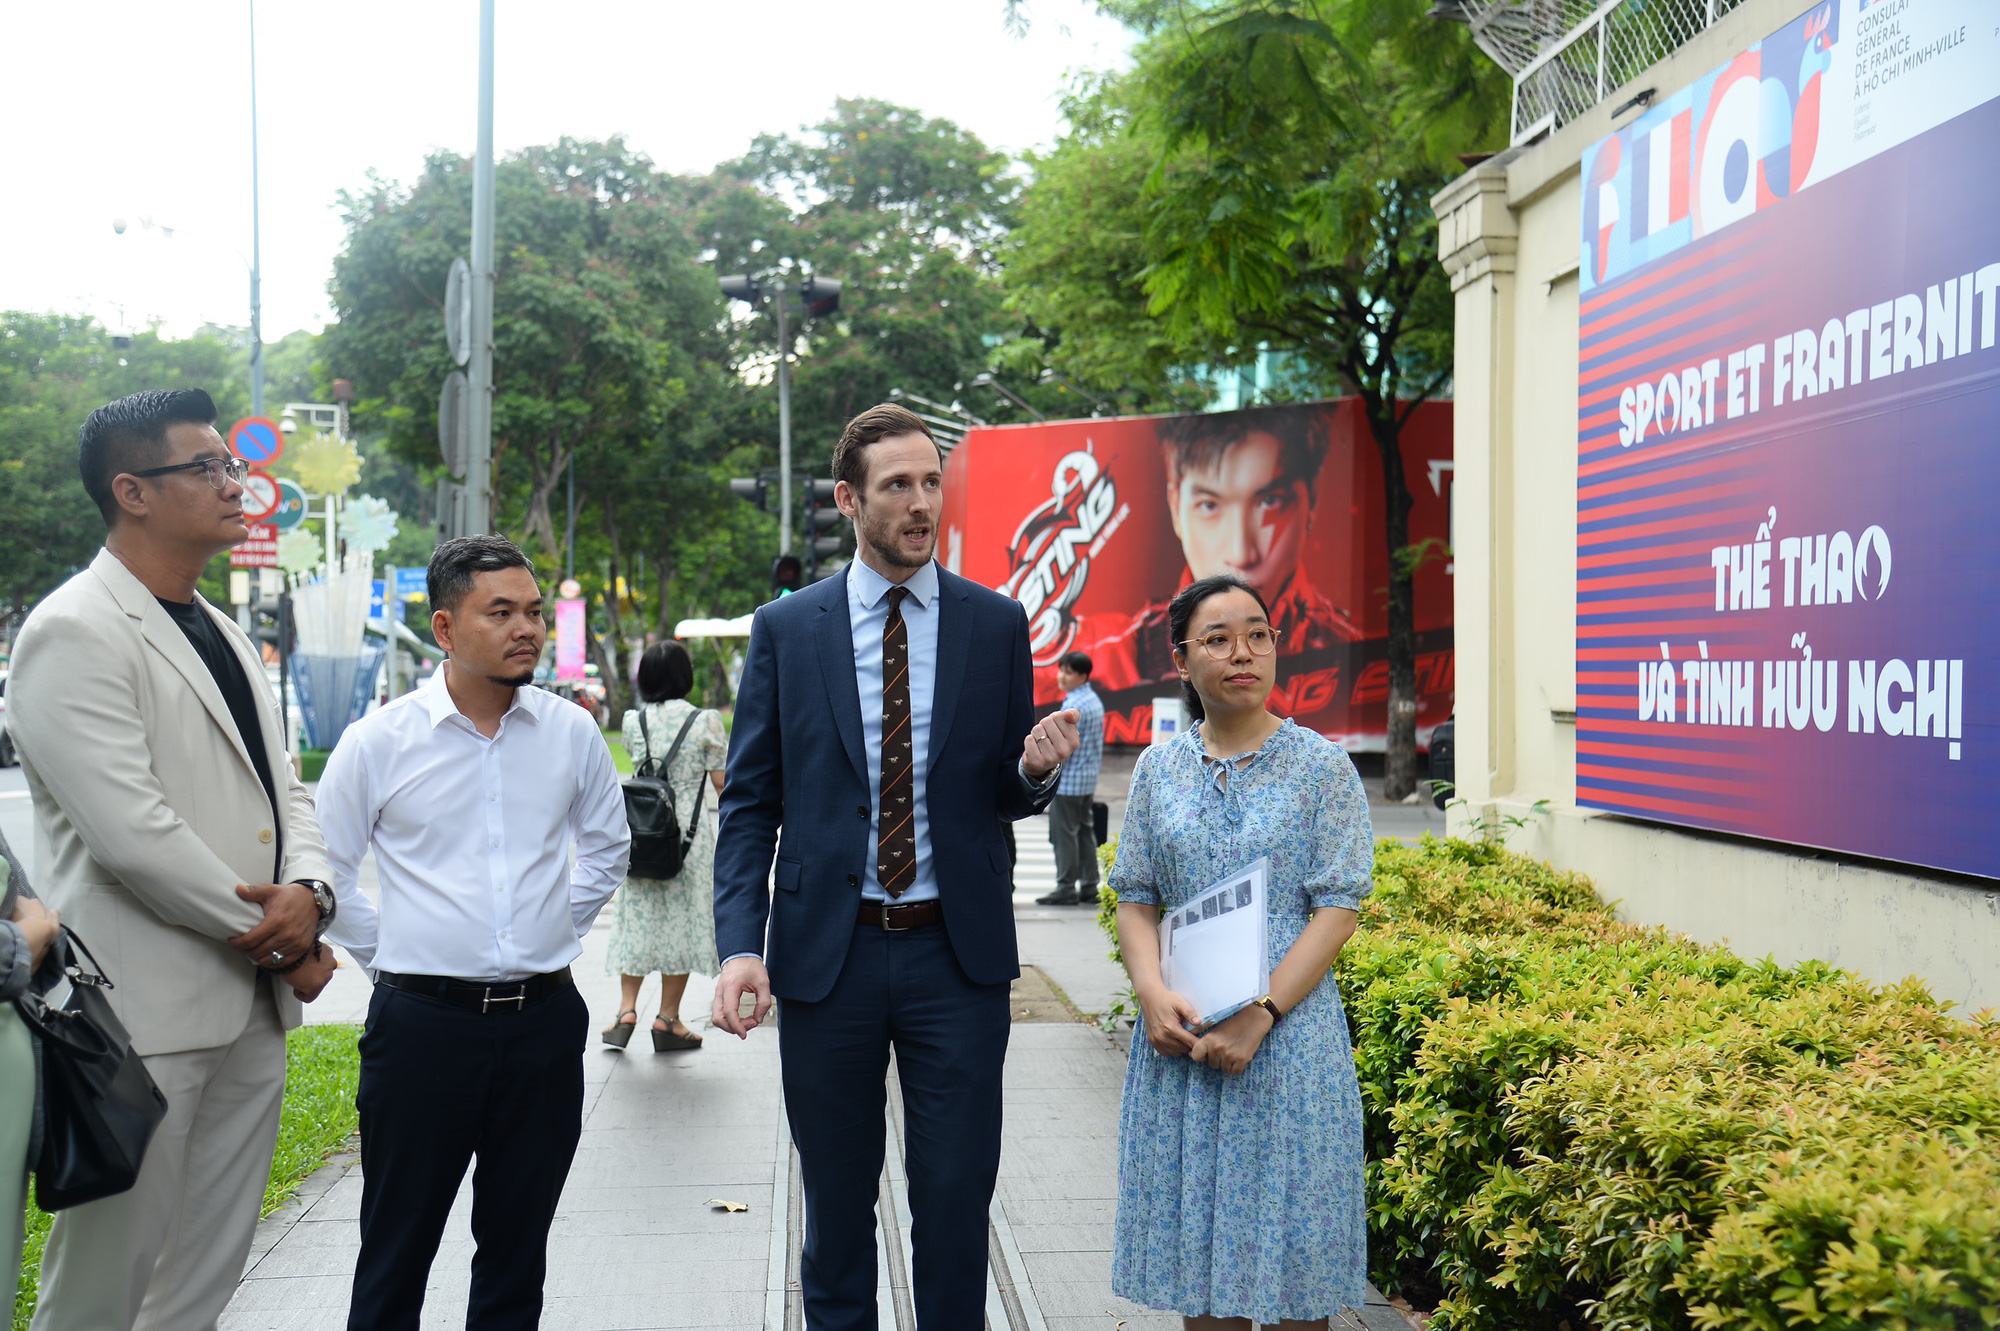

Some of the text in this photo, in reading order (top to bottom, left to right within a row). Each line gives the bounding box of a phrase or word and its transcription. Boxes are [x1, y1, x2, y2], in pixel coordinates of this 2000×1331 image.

[1855, 35, 1910, 79] DE FRANCE
[1856, 20, 1901, 57] GÉNÉRAL
[1881, 62, 1900, 84] CHI
[1903, 25, 1966, 73] MINH-VILLE
[1618, 358, 1720, 448] SPORT
[1727, 343, 1766, 420] ET
[1016, 476, 1116, 623] STING
[1711, 505, 1892, 612] THỂ THAO
[1638, 631, 1963, 761] VÀ TÌNH HỮU NGHỊ
